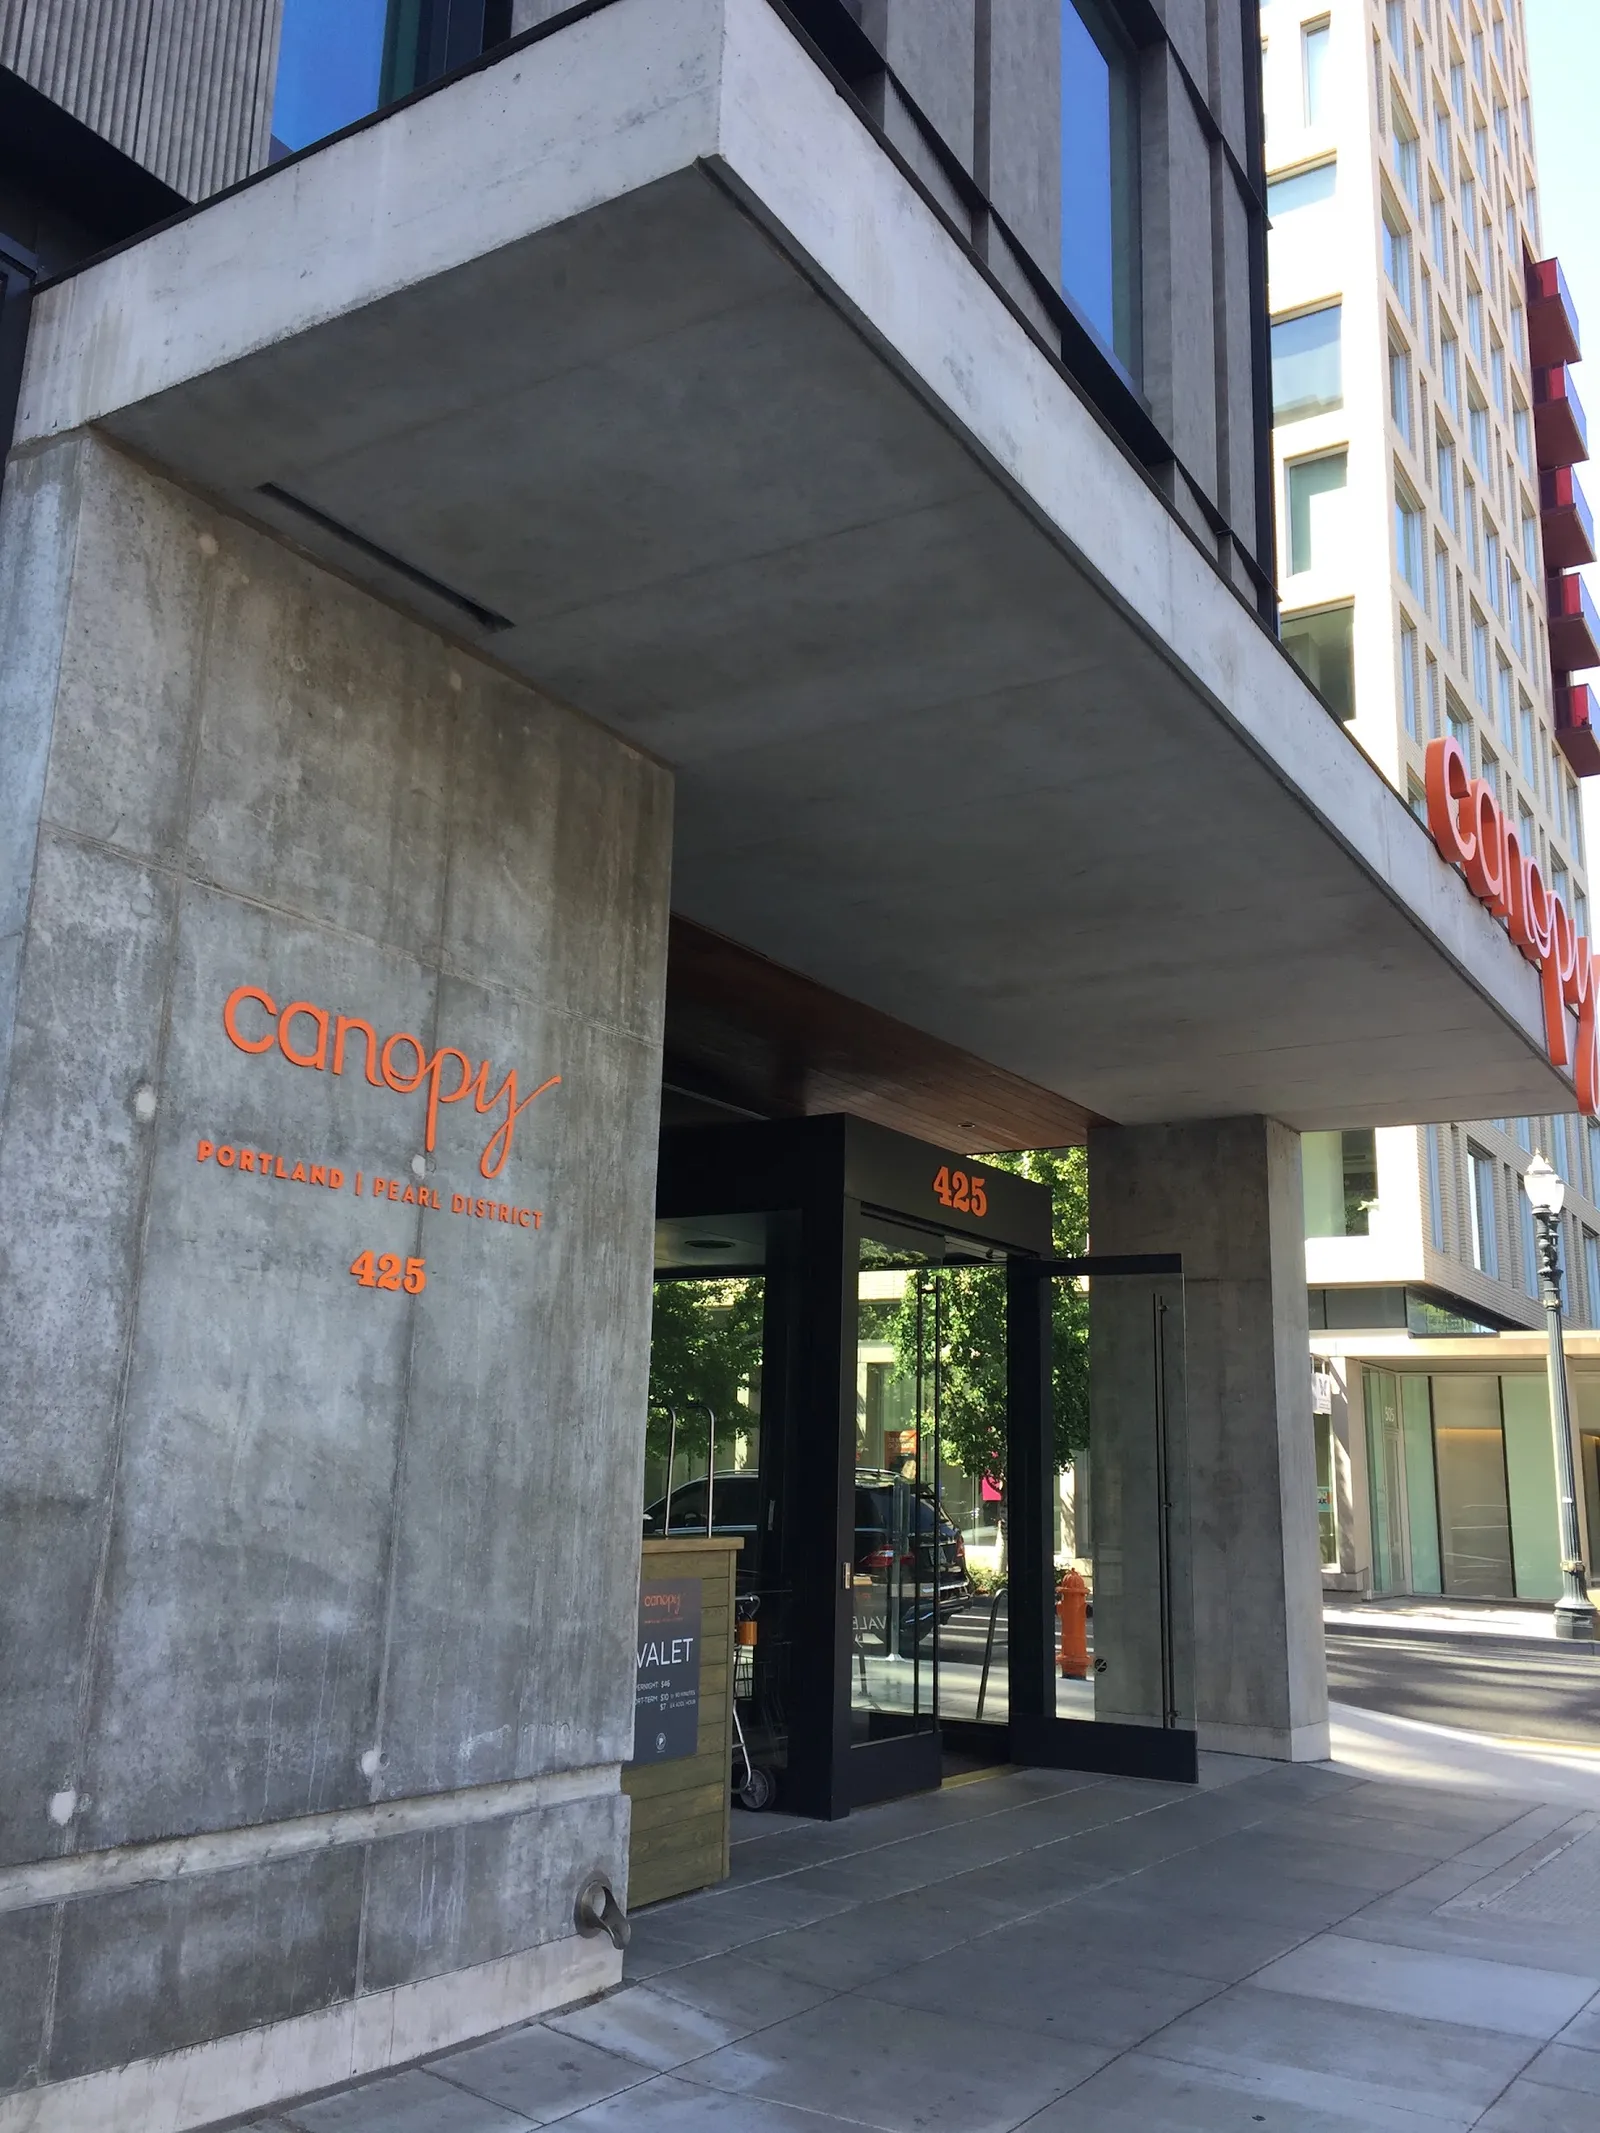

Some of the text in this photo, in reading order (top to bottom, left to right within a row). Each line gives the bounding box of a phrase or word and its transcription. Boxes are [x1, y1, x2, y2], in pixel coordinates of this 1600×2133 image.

[1425, 736, 1600, 1117] canopy
[224, 986, 562, 1179] canopy
[197, 1140, 345, 1190] PORTLAND
[372, 1178, 441, 1210] PEARL
[452, 1194, 543, 1230] DISTRICT
[933, 1166, 988, 1218] 425
[350, 1250, 427, 1295] 425
[636, 1638, 694, 1669] VALET
[636, 1681, 659, 1691] ERNIGHT
